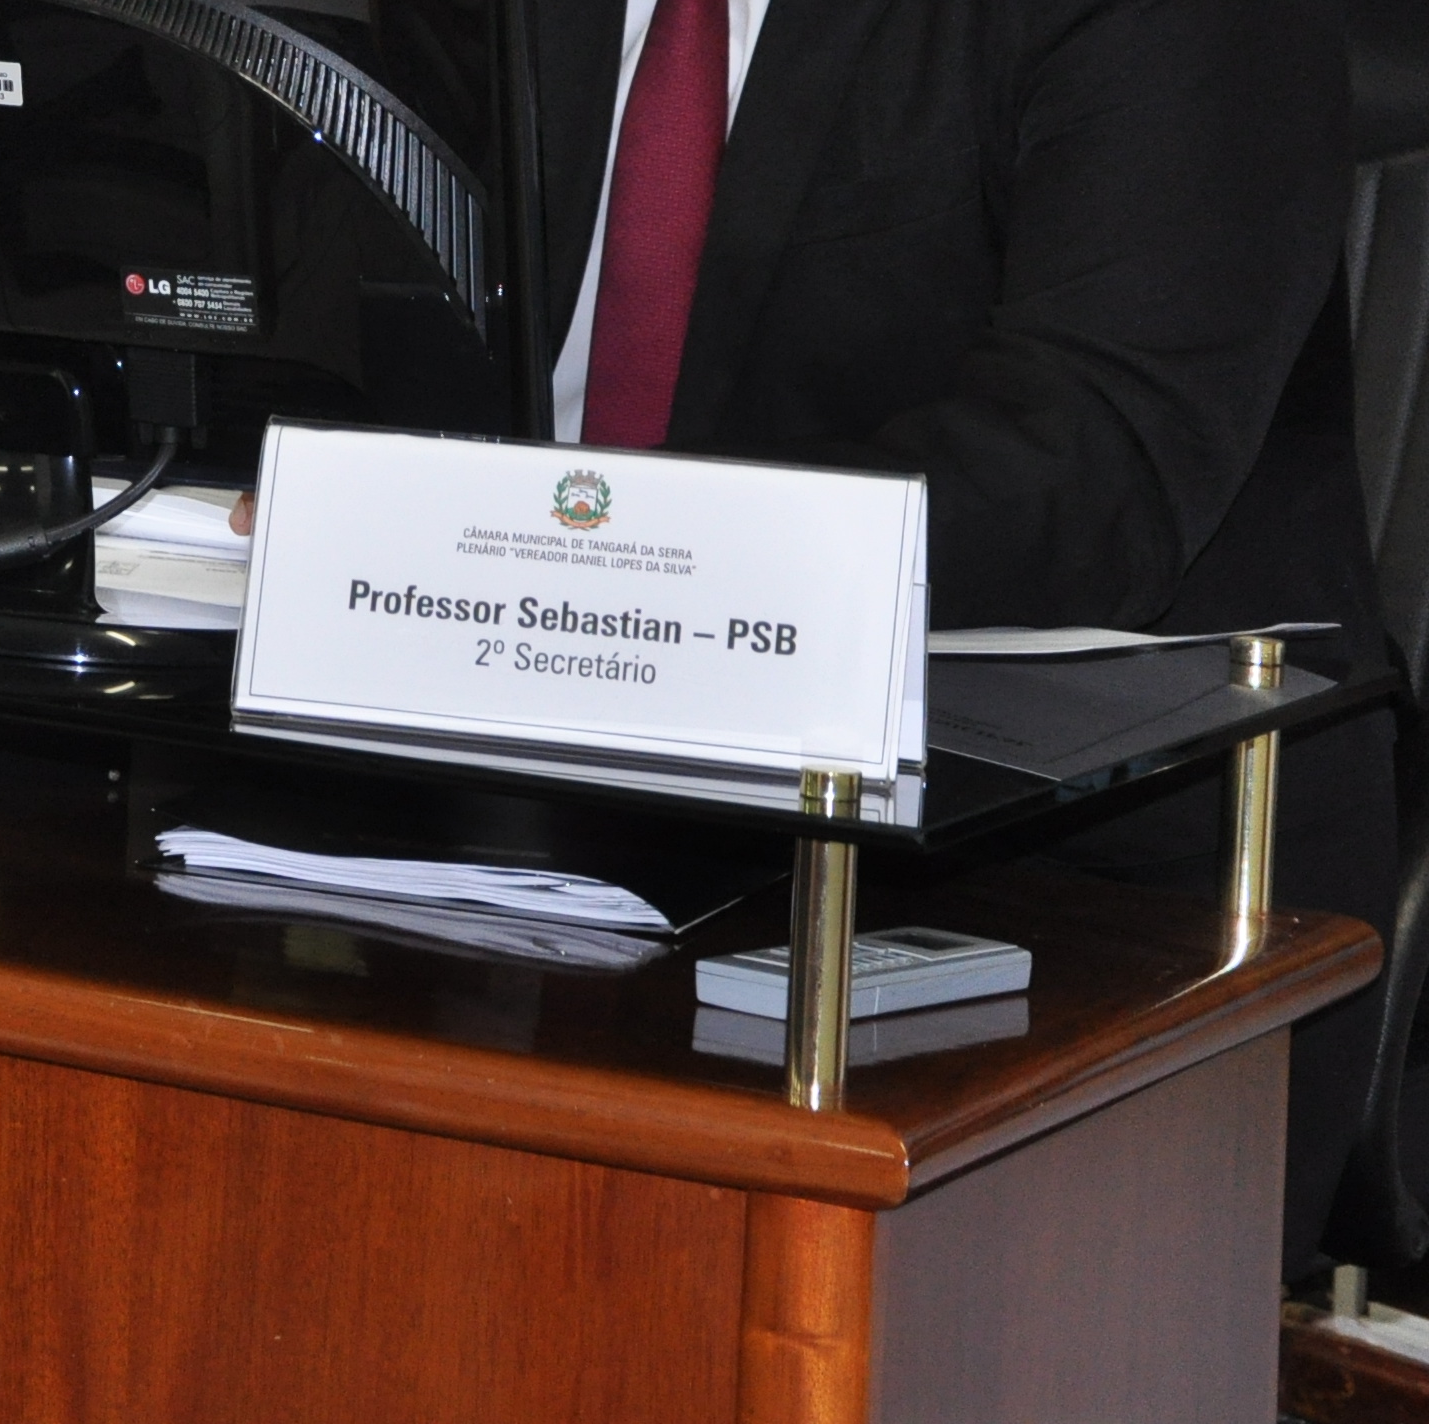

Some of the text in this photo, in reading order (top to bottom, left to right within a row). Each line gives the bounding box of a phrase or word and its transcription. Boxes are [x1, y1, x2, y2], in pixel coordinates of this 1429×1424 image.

[148, 278, 171, 295] LG
[176, 275, 195, 285] SAC
[456, 542, 507, 557] PLENÁRIO
[571, 553, 607, 568] DANIEL
[611, 558, 643, 571] LOPES
[645, 560, 661, 573] DA
[463, 526, 693, 561] CÂMARA MUNICIPAL DE TANGARÁ DA SERRA
[348, 579, 507, 625] Professor
[517, 596, 682, 644] Sebastian
[727, 618, 798, 656] PSB
[514, 642, 657, 685] Secretário
